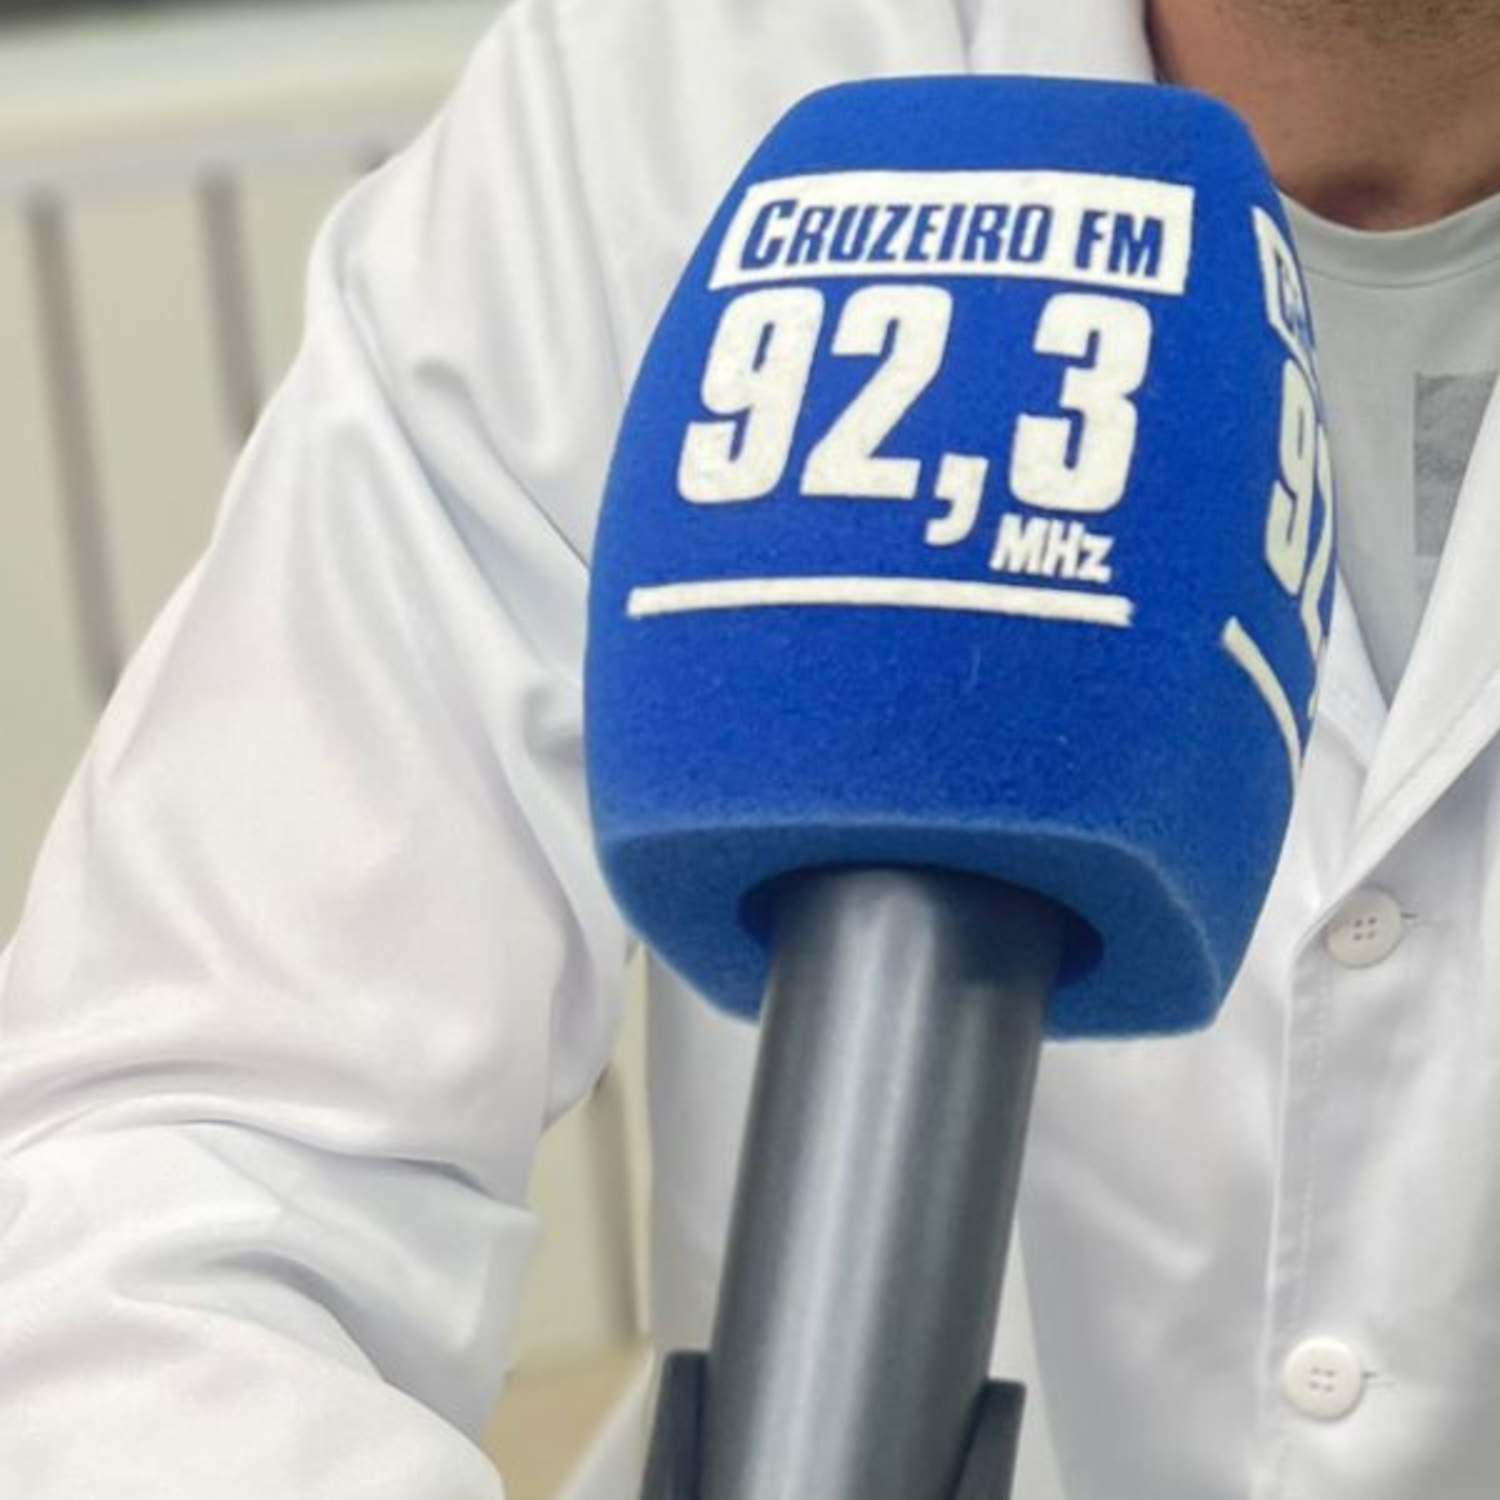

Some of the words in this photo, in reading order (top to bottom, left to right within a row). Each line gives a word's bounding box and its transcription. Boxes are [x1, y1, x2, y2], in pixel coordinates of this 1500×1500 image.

[739, 199, 1054, 271] CRUZEIRO
[1074, 208, 1165, 278] FM
[677, 284, 1153, 546] 92,3
[989, 512, 1116, 583] MHz
